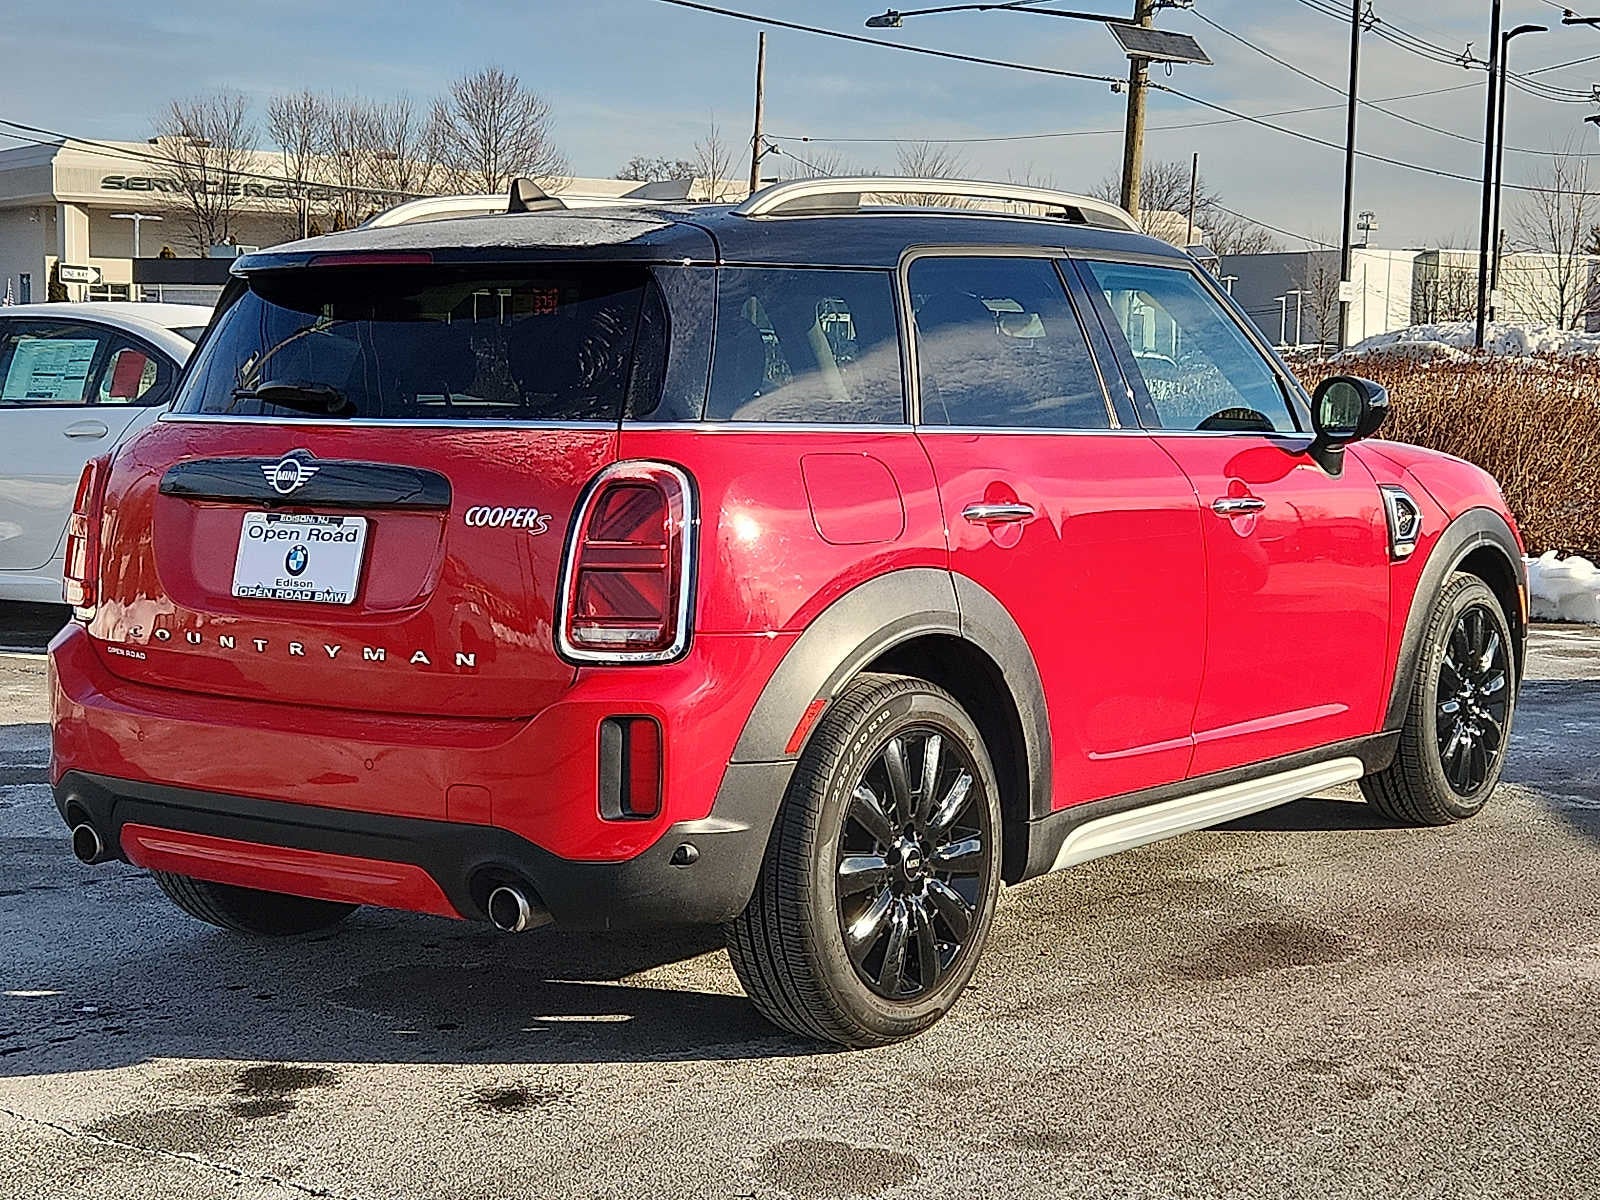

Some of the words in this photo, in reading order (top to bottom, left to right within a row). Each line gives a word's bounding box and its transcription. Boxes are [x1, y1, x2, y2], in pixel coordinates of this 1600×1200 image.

[276, 470, 298, 482] MINI
[465, 506, 539, 528] COOPER
[248, 525, 300, 542] Open
[306, 528, 358, 543] Road
[275, 578, 313, 588] Edison
[238, 587, 273, 597] OPEN
[275, 589, 312, 600] ROAD
[314, 591, 347, 602] BMW
[107, 646, 125, 656] OPEN
[125, 649, 146, 660] ROAD
[128, 625, 476, 667] COUNTRYMAN
